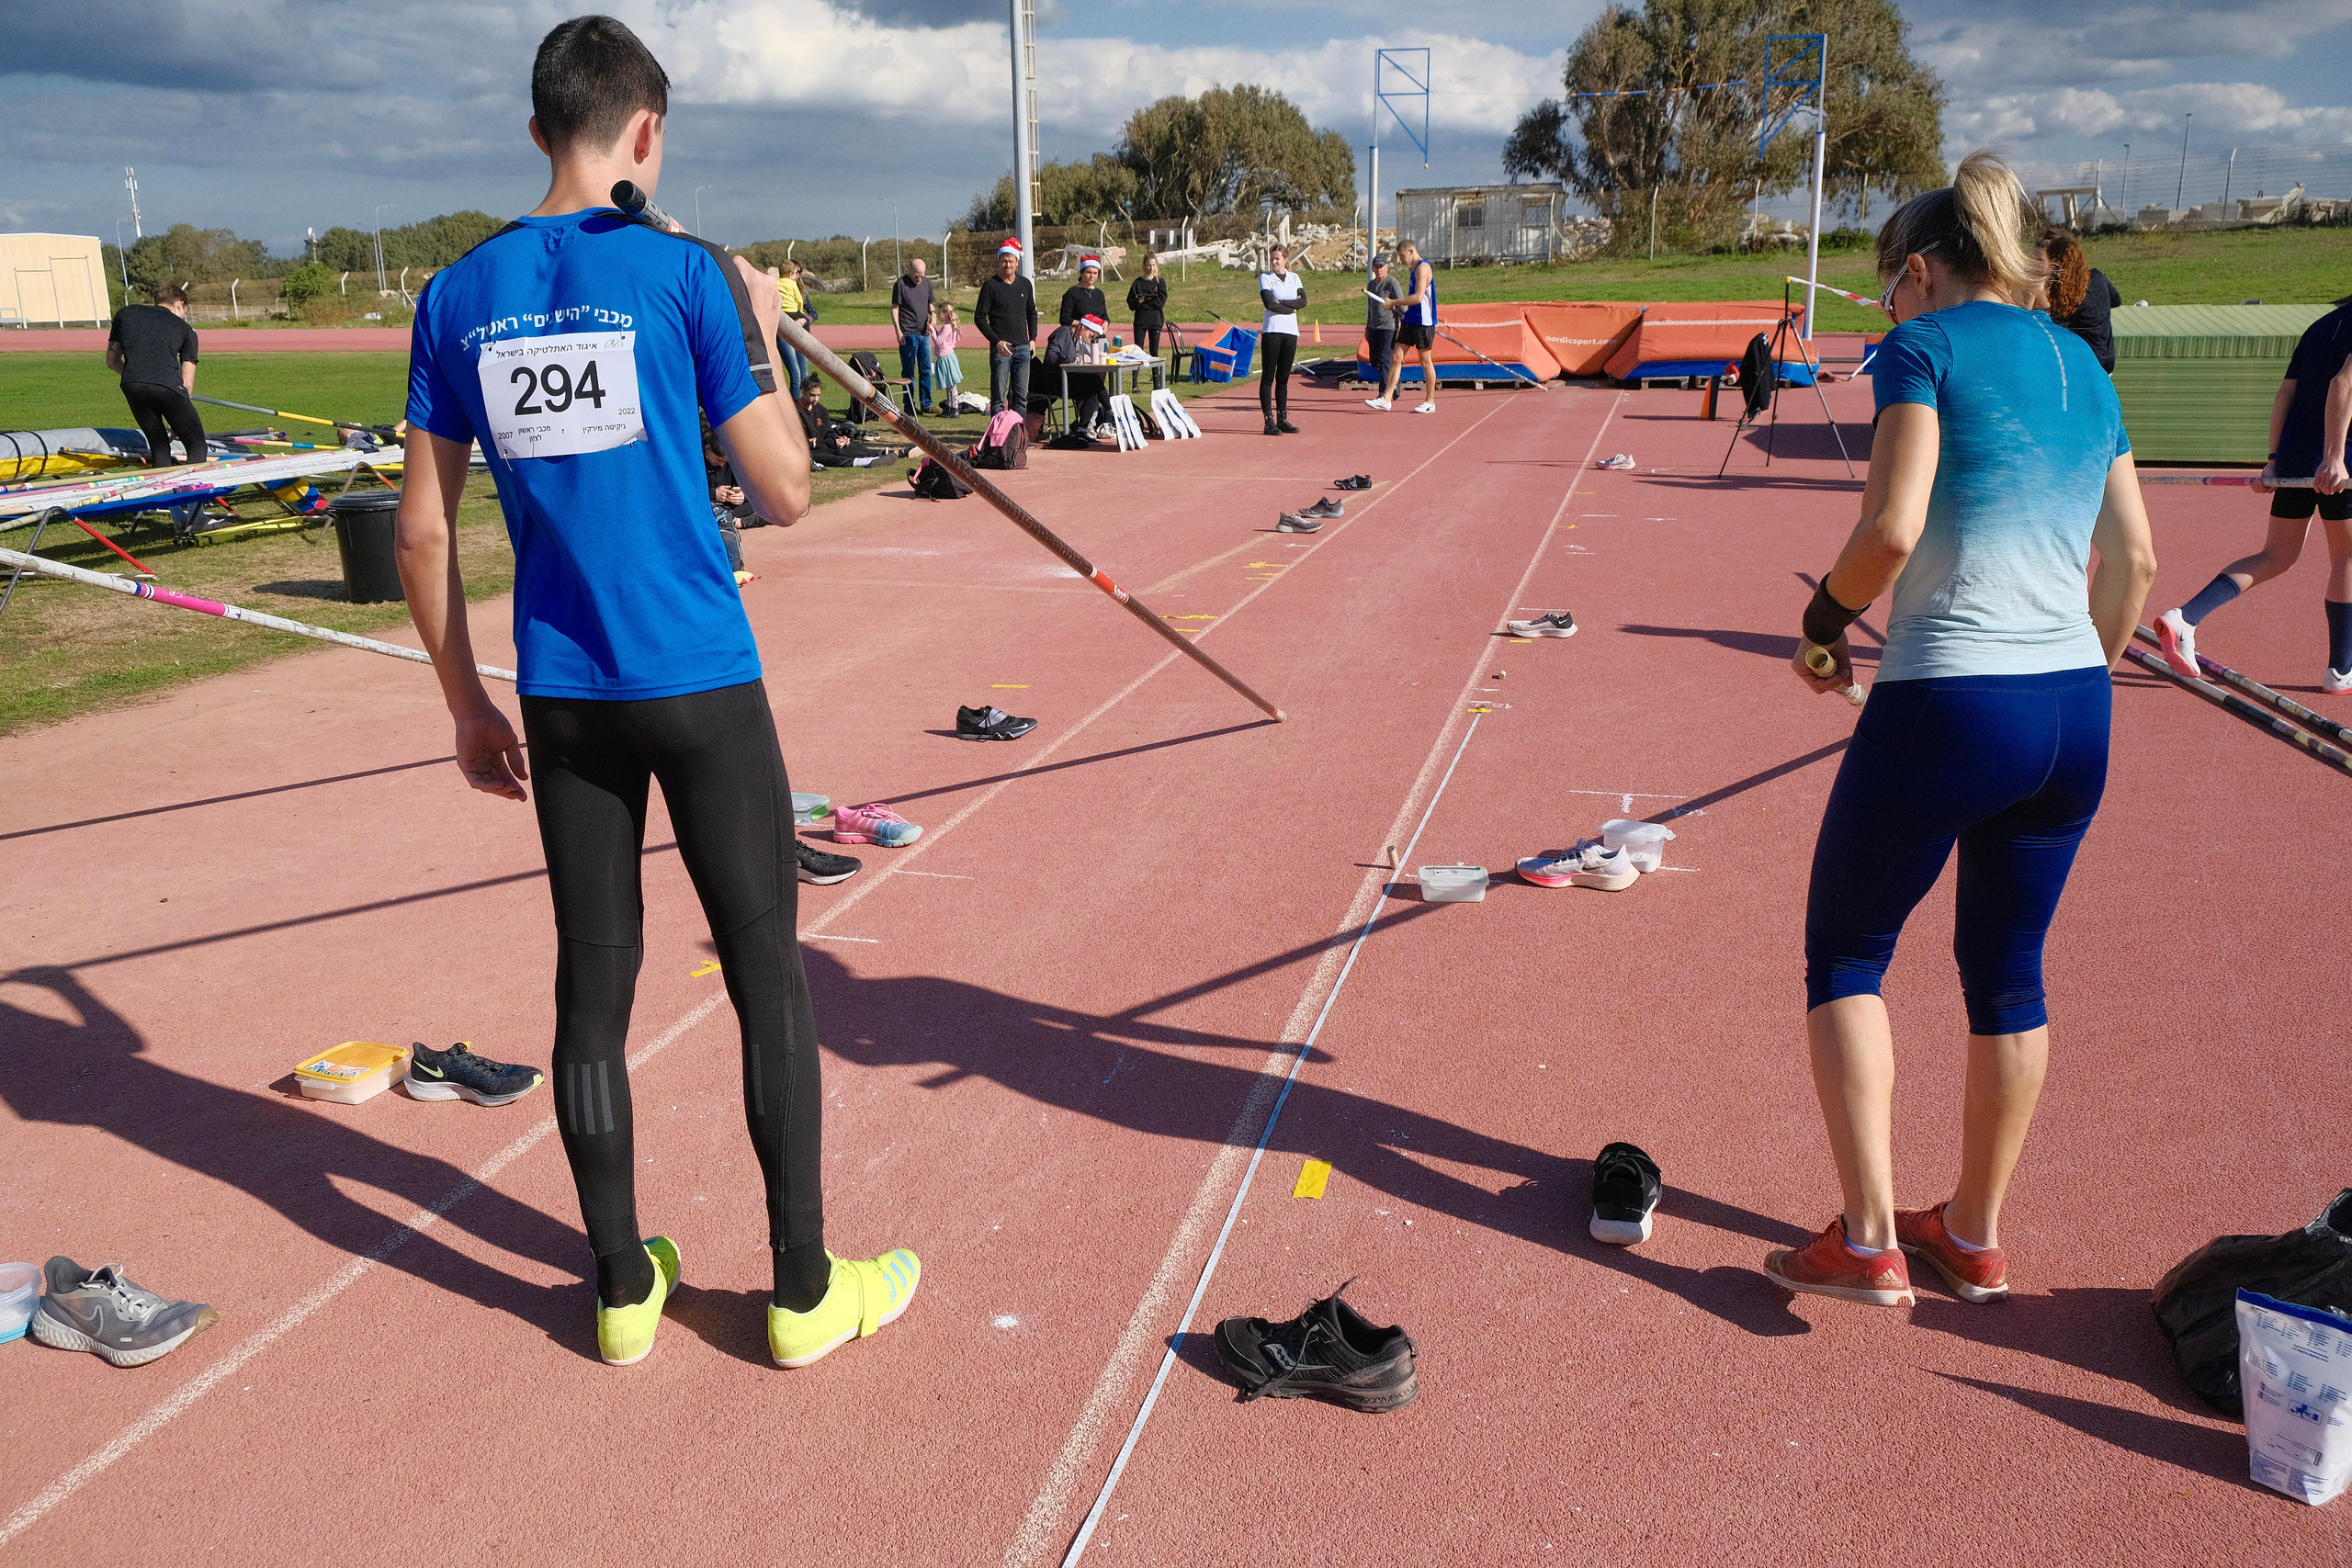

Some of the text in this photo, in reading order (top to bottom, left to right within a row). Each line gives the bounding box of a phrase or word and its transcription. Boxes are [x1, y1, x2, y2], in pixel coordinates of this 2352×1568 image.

[594, 308, 633, 328] מכבי
[1544, 335, 1617, 346] nordicsport.com
[495, 343, 598, 359] איגוד האתלטיקה בישראל
[510, 360, 606, 415] 294
[617, 407, 636, 416] 2022
[517, 427, 535, 435] ראשון
[604, 423, 627, 432] ניקיטה
[497, 431, 514, 440] 2007
